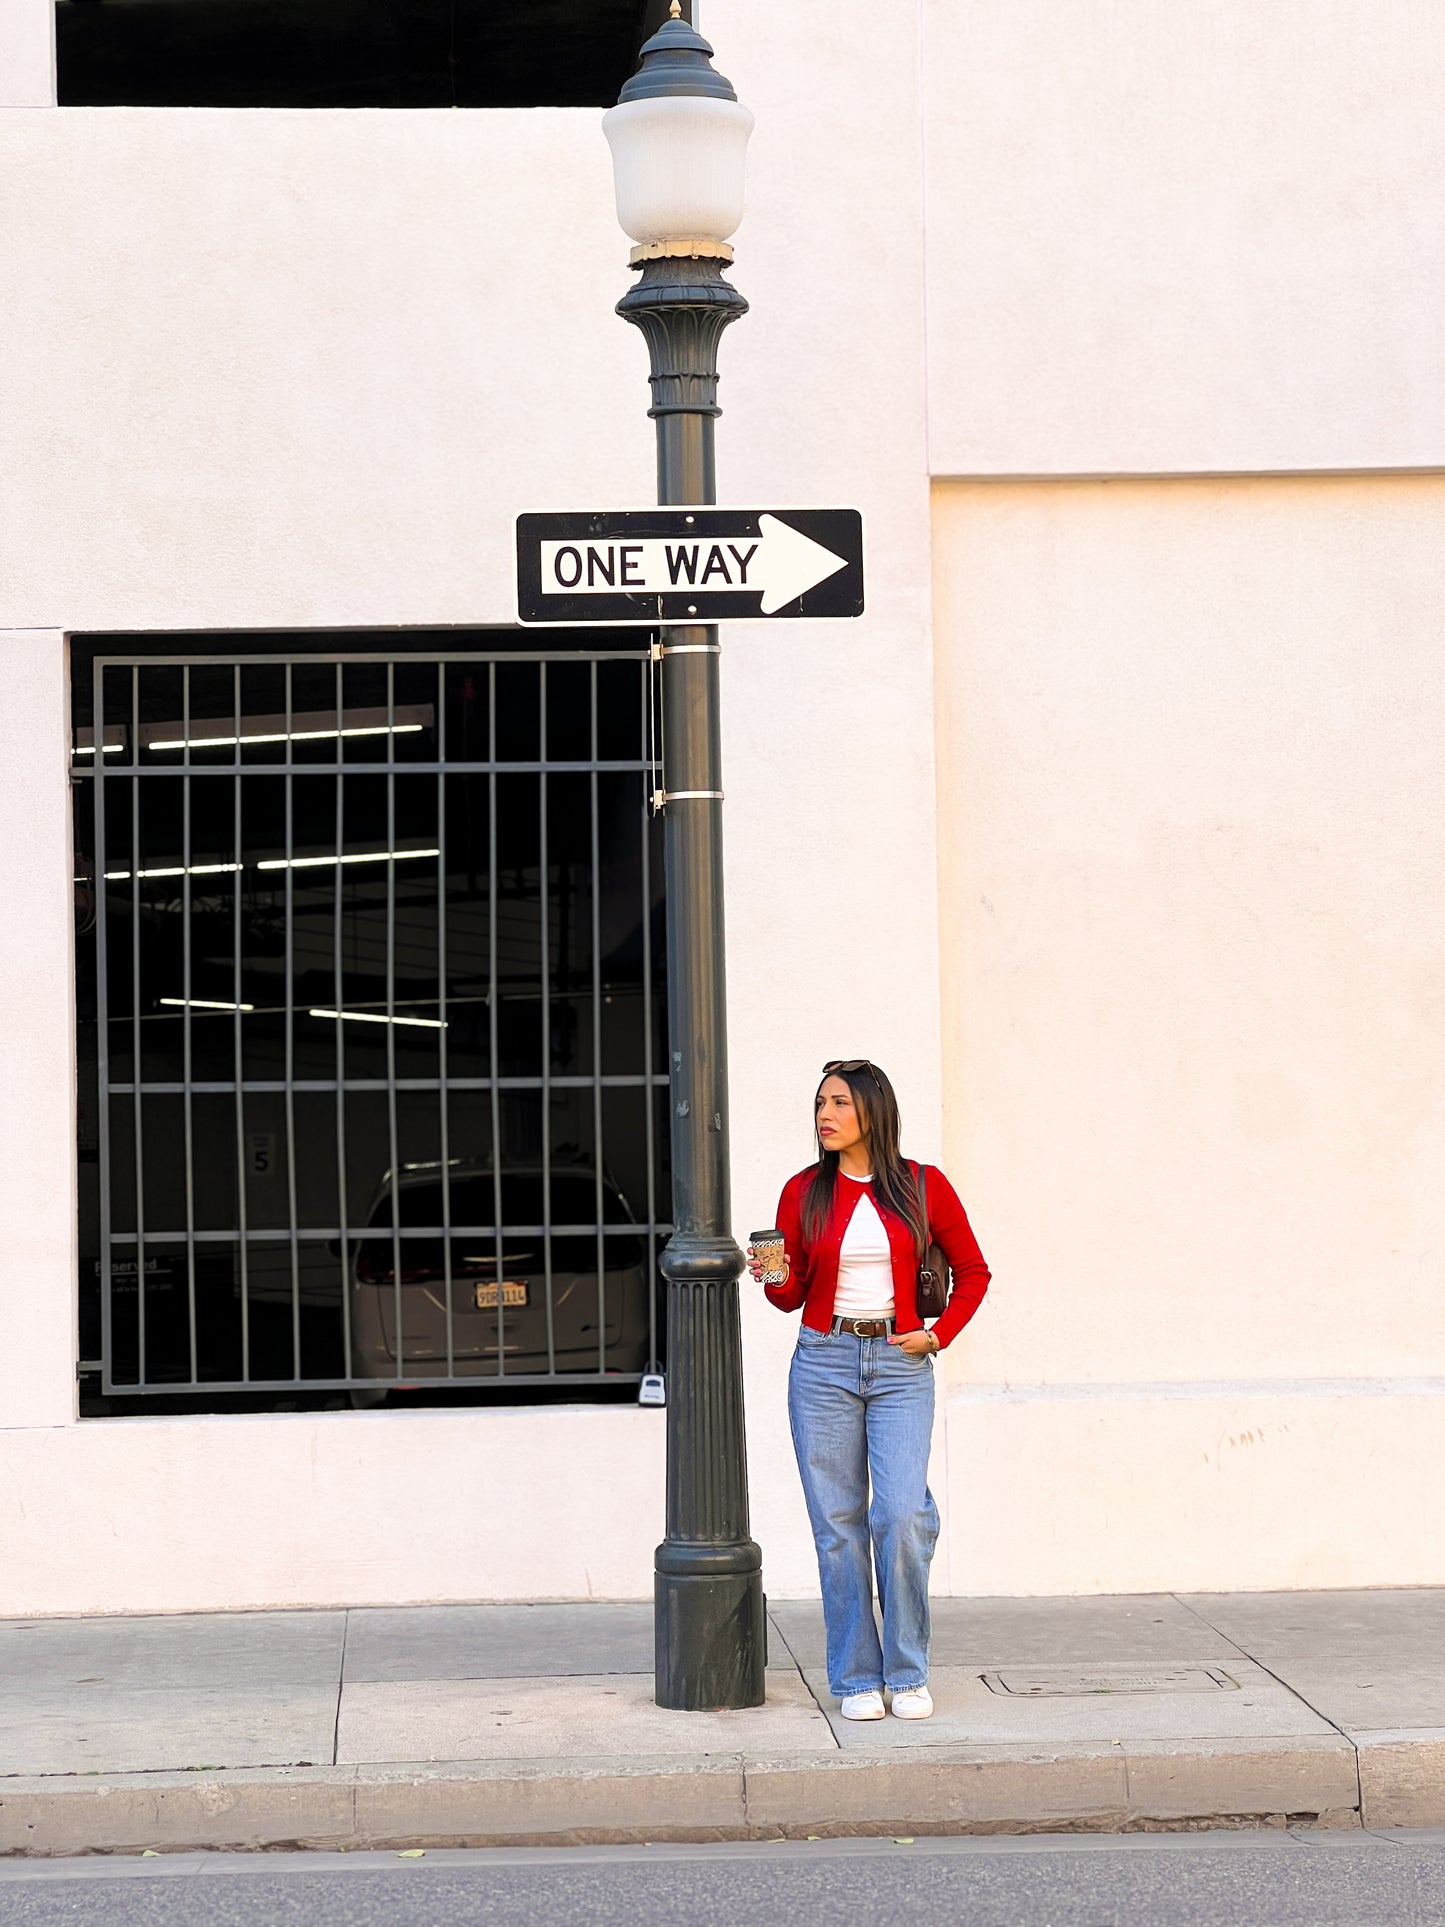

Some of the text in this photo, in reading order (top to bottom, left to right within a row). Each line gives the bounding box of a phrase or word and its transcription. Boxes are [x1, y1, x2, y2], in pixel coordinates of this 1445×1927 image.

[554, 544, 760, 588] ONE WAY
[255, 1152, 268, 1171] 5
